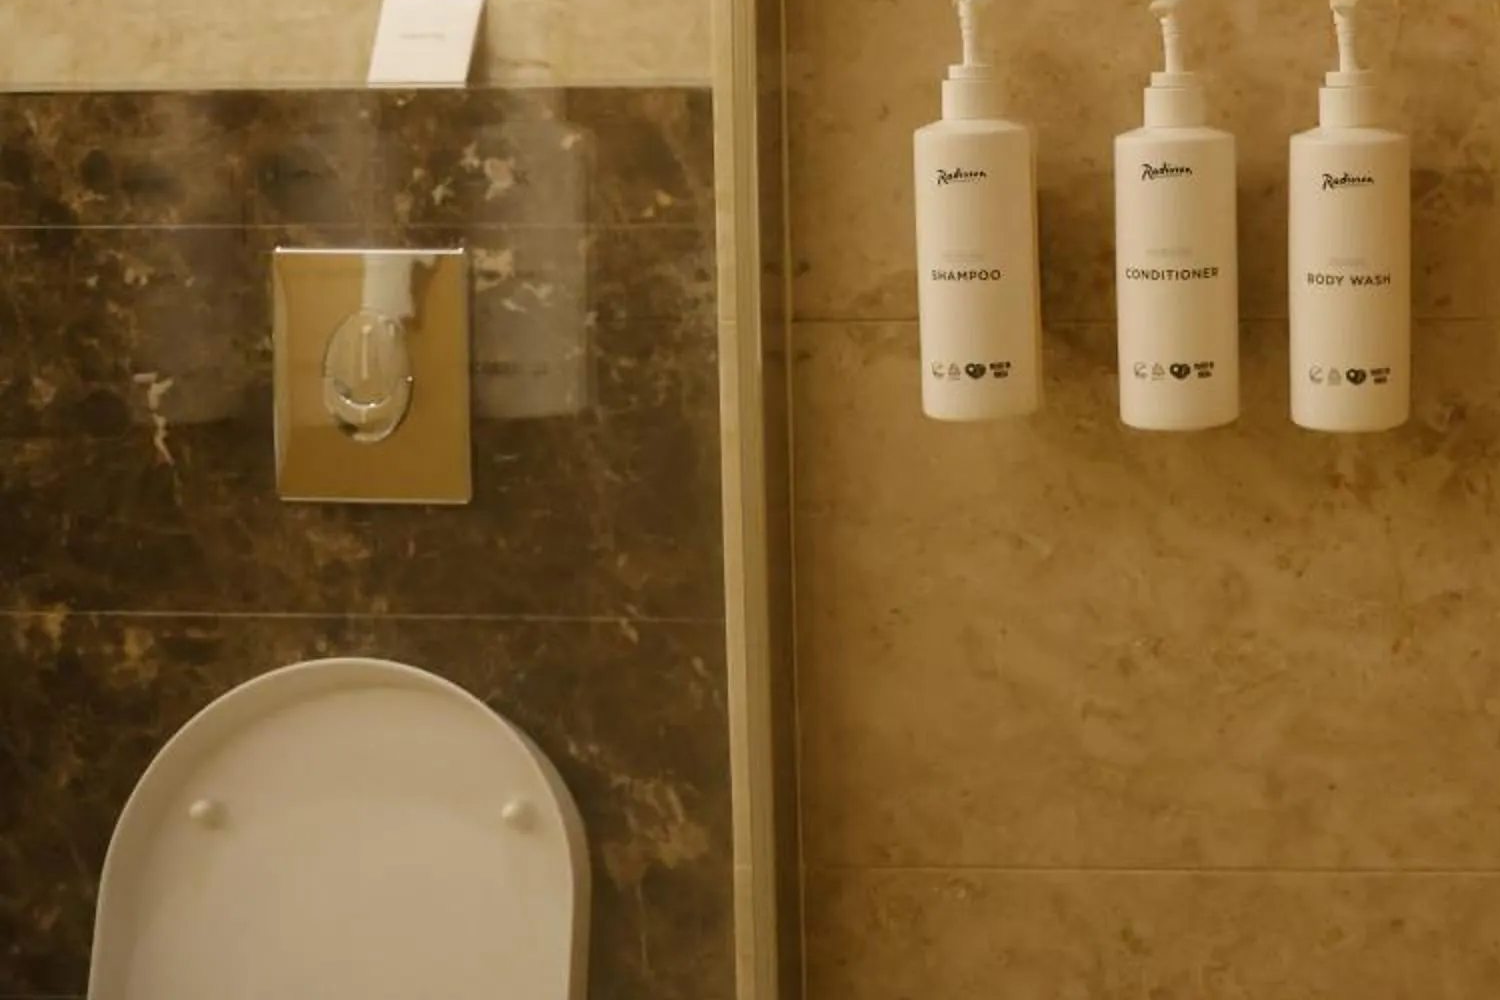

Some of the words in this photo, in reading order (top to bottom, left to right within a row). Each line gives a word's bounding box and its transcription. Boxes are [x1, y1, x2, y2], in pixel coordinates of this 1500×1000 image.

[936, 167, 988, 184] Radisson
[931, 269, 1001, 281] SHAMPOO
[1125, 267, 1219, 281] CONDITIONER
[1307, 272, 1344, 286] BODY
[1350, 272, 1391, 286] WASH
